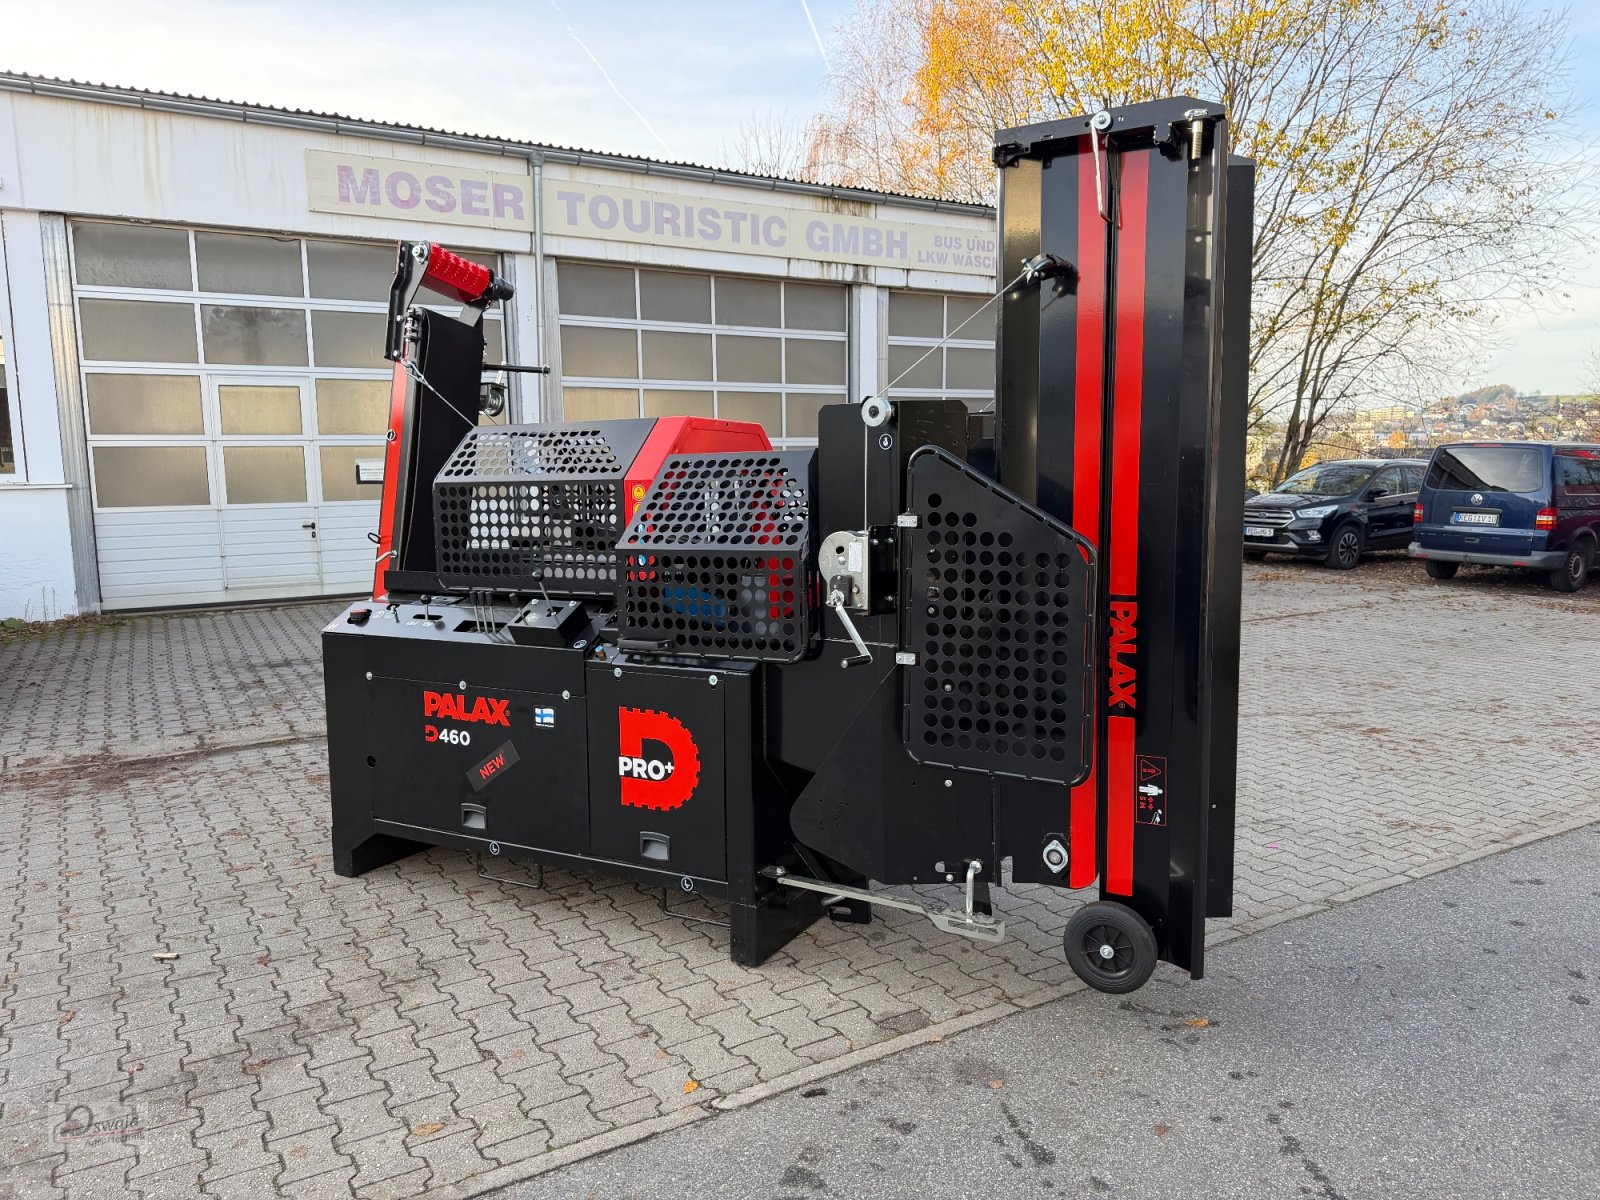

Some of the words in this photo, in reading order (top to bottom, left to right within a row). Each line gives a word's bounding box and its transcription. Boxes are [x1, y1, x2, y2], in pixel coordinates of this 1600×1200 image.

[337, 164, 525, 221] MOSER
[557, 189, 788, 248] TOURISTIC
[805, 219, 909, 260] GMBH
[934, 235, 962, 249] BUS
[966, 238, 995, 253] UND
[917, 251, 947, 265] LKW
[479, 753, 506, 780] NEW
[618, 756, 675, 781] PRO+
